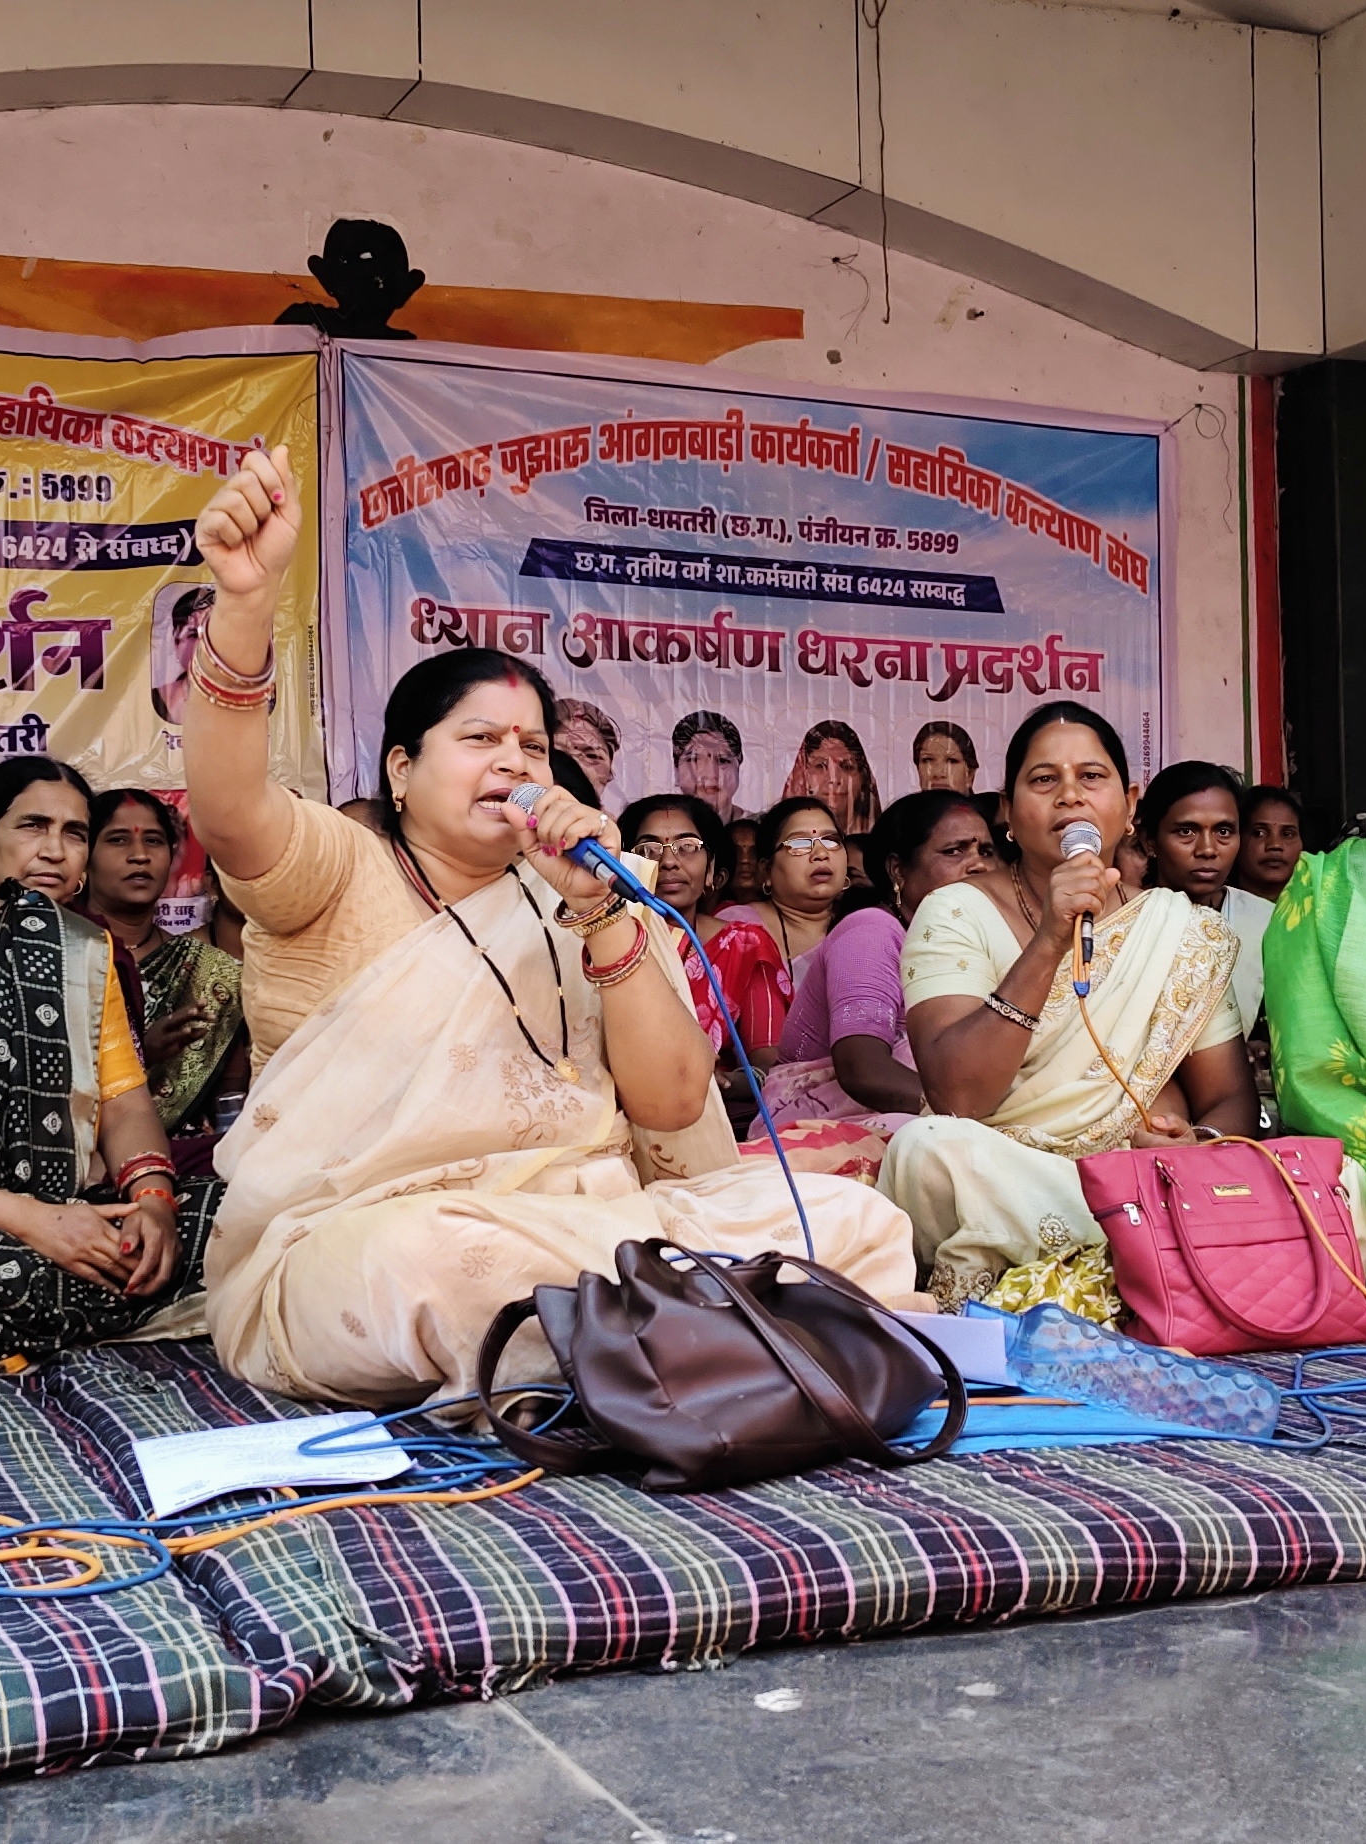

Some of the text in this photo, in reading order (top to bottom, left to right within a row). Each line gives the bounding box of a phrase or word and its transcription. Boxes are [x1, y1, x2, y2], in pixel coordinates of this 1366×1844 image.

[111, 412, 230, 477] कल्याण
[41, 473, 112, 503] 5899
[360, 444, 492, 529] छत्तीसगढ़
[498, 427, 591, 494] जुझारू
[598, 409, 745, 472] आंगनबाड़ी
[750, 419, 860, 475] कार्यकर्ता
[886, 446, 1002, 516] सहायिका
[1005, 481, 1103, 564] कल्याण
[1107, 533, 1150, 595] संघ
[1, 538, 68, 562] 6424
[75, 531, 100, 561] से
[584, 497, 716, 534] जिला-धमतरी
[798, 516, 870, 547] पंजीयन
[875, 526, 902, 550] क्र.
[907, 531, 959, 554] 5899
[574, 551, 620, 576] छ.ग.
[625, 551, 677, 583] तृतीय
[681, 557, 711, 582] वर्ग
[821, 569, 853, 594] संघ
[857, 576, 906, 598] 6424
[909, 579, 966, 606] सम्बद्ध
[410, 597, 1104, 702] ध्यान आकर्षण धरना प्रदर्शन
